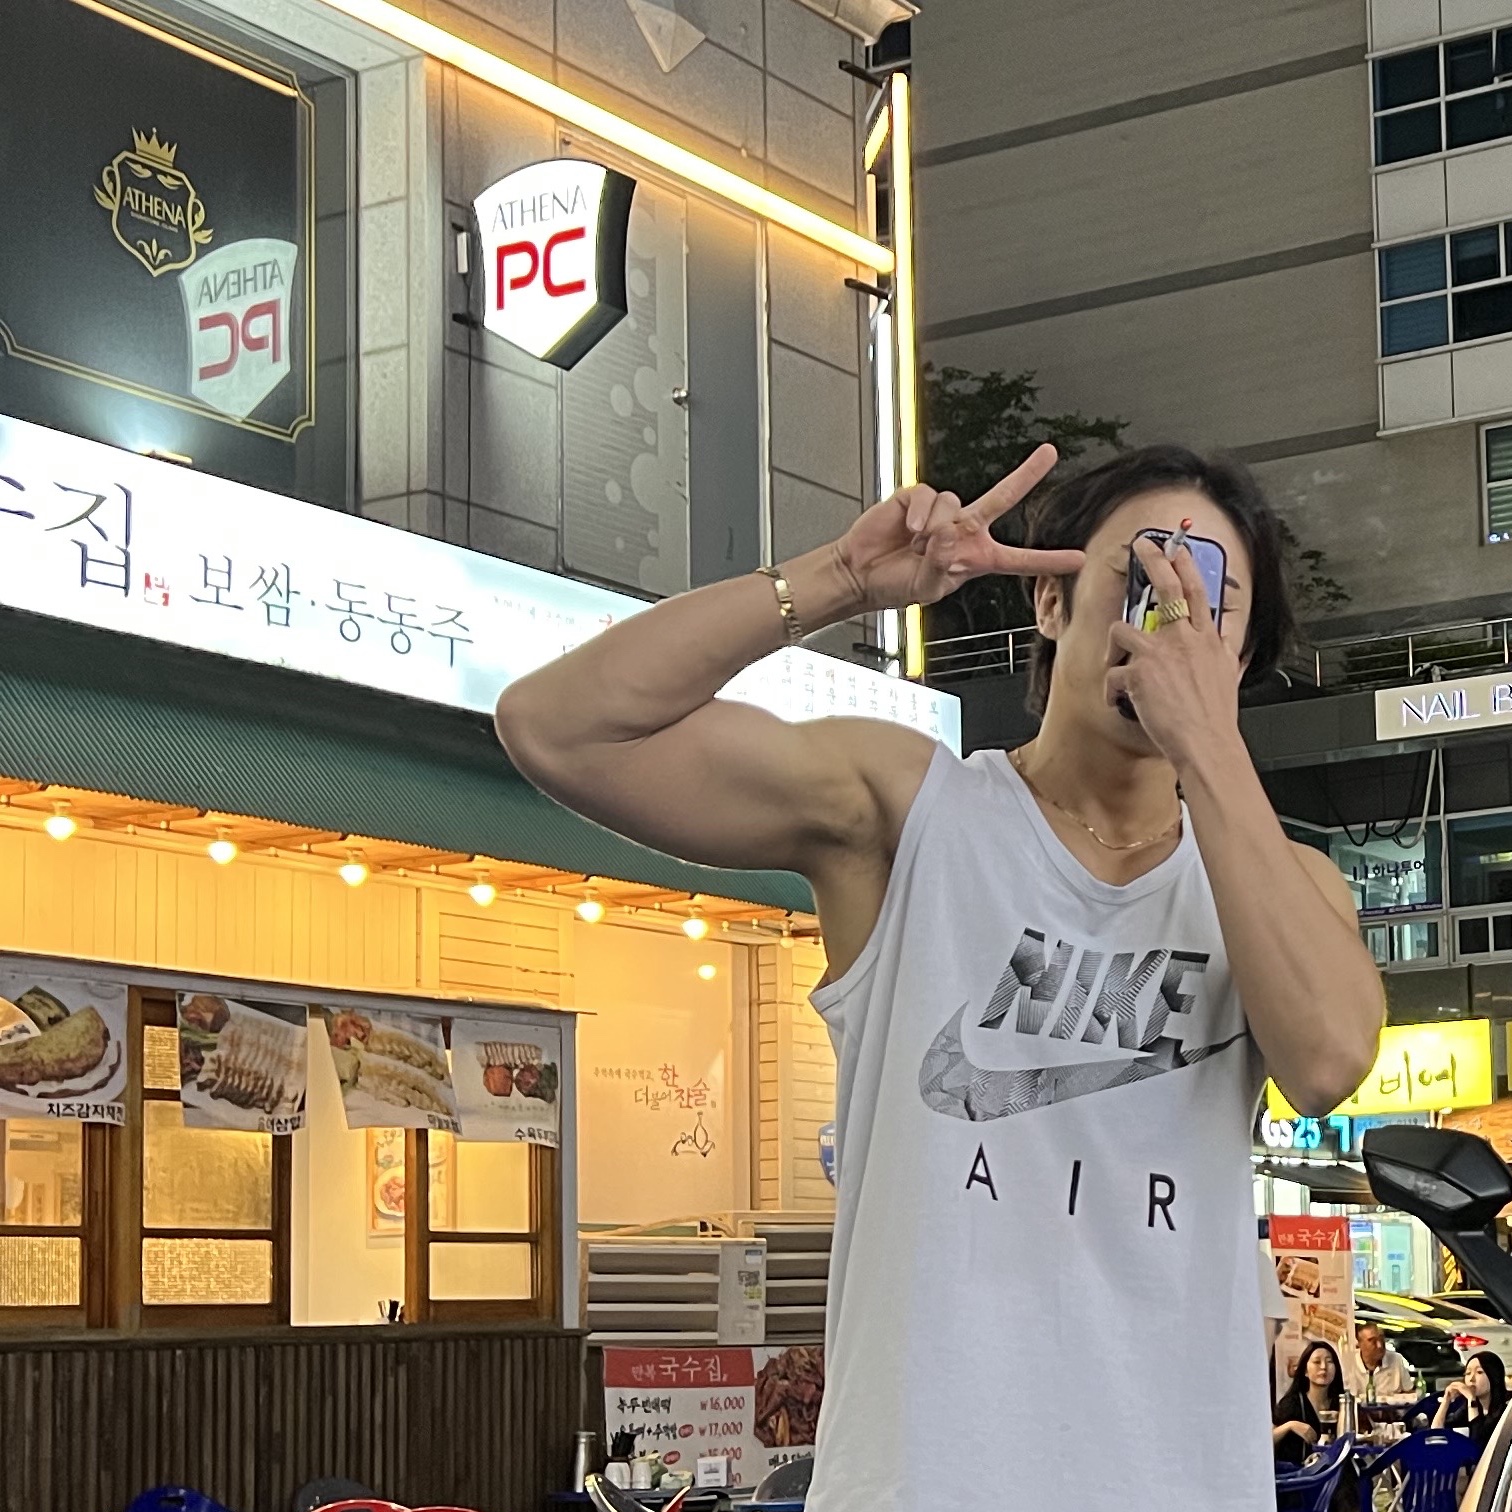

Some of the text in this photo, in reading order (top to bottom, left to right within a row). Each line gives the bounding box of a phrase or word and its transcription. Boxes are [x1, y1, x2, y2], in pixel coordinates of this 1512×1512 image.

[123, 186, 186, 229] ATHENA
[492, 185, 587, 232] ATHENA
[496, 226, 586, 311] PC
[1402, 689, 1480, 728] NAIL
[978, 927, 1210, 1055] NIKE
[965, 1141, 1177, 1232] AIR
[658, 1354, 722, 1383] 국수집
